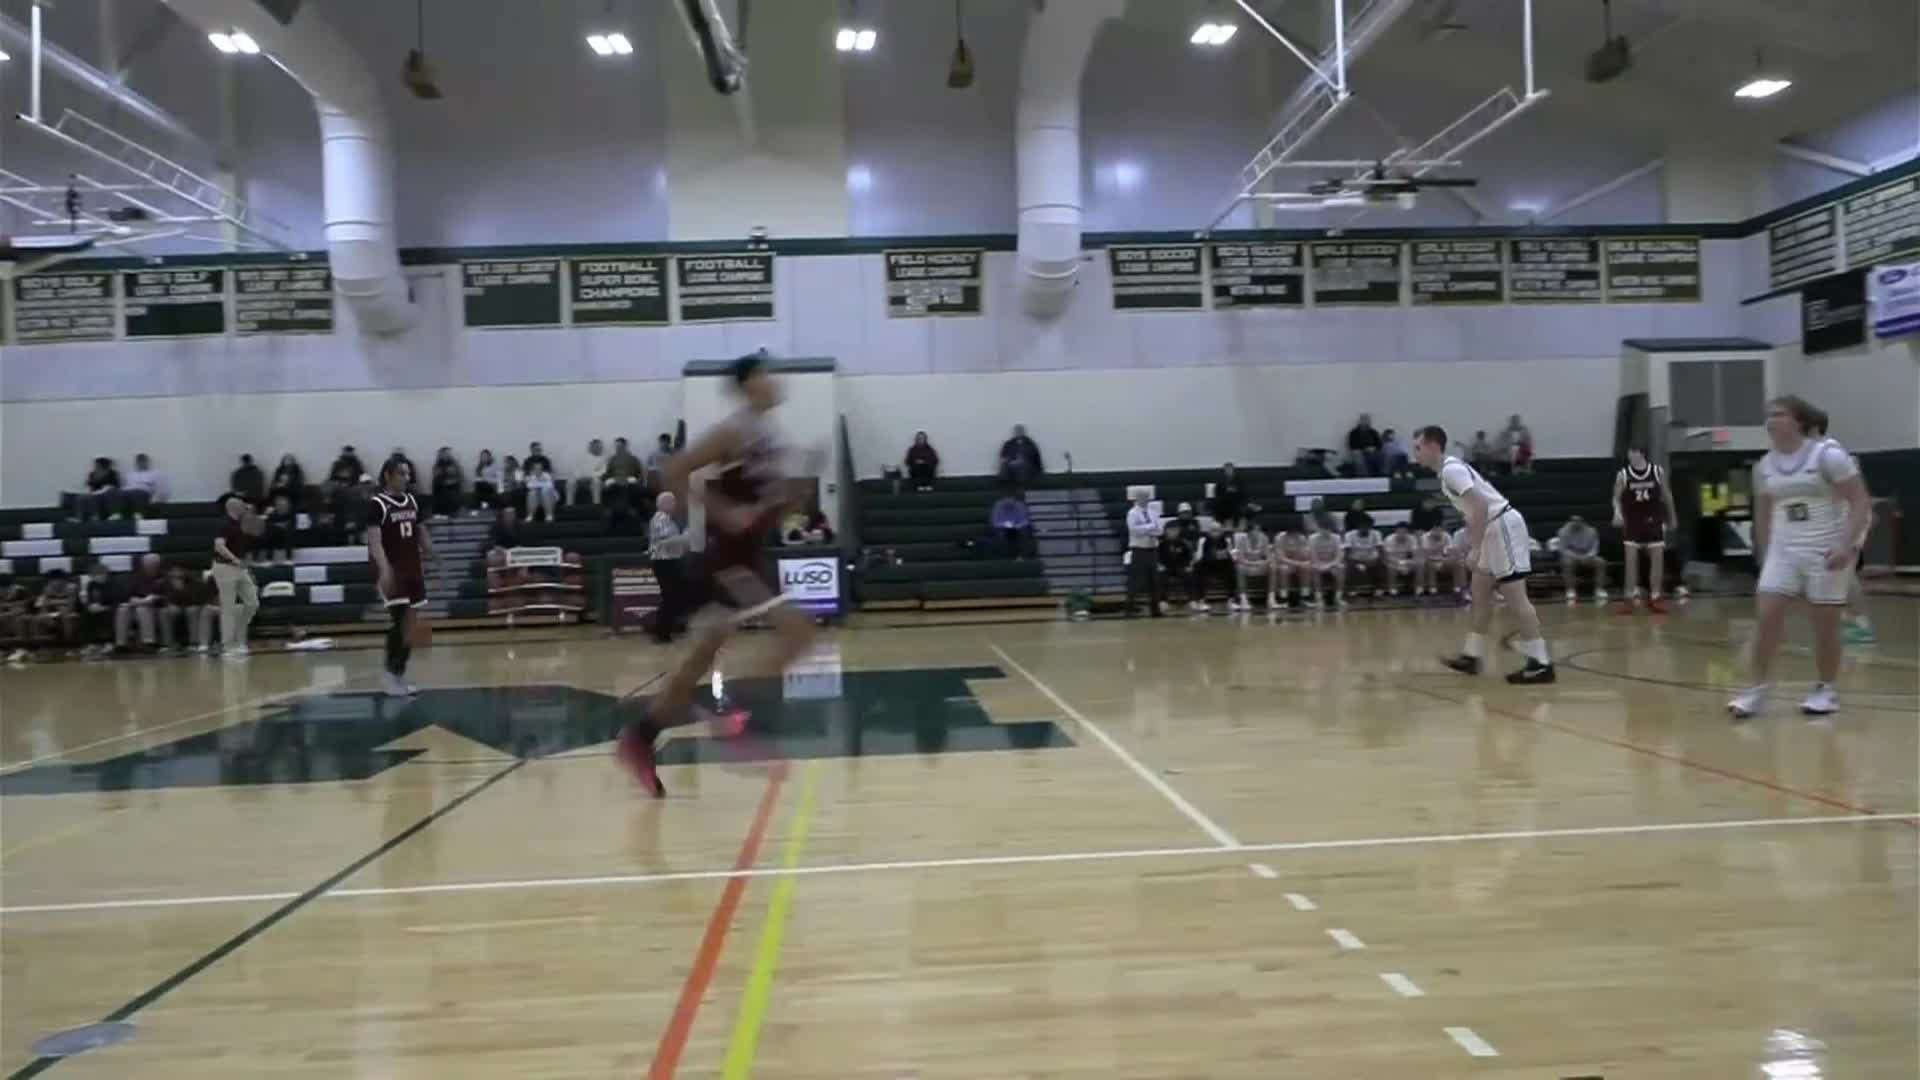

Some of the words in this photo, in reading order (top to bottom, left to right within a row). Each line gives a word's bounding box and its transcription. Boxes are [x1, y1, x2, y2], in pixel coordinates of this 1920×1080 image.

[579, 261, 659, 273] FOOTBALL
[684, 259, 765, 271] FOOTBALL
[580, 275, 621, 286] SUPER
[580, 287, 661, 299] CHAMPIONS
[400, 521, 413, 538] 13
[785, 569, 833, 585] LUSO
